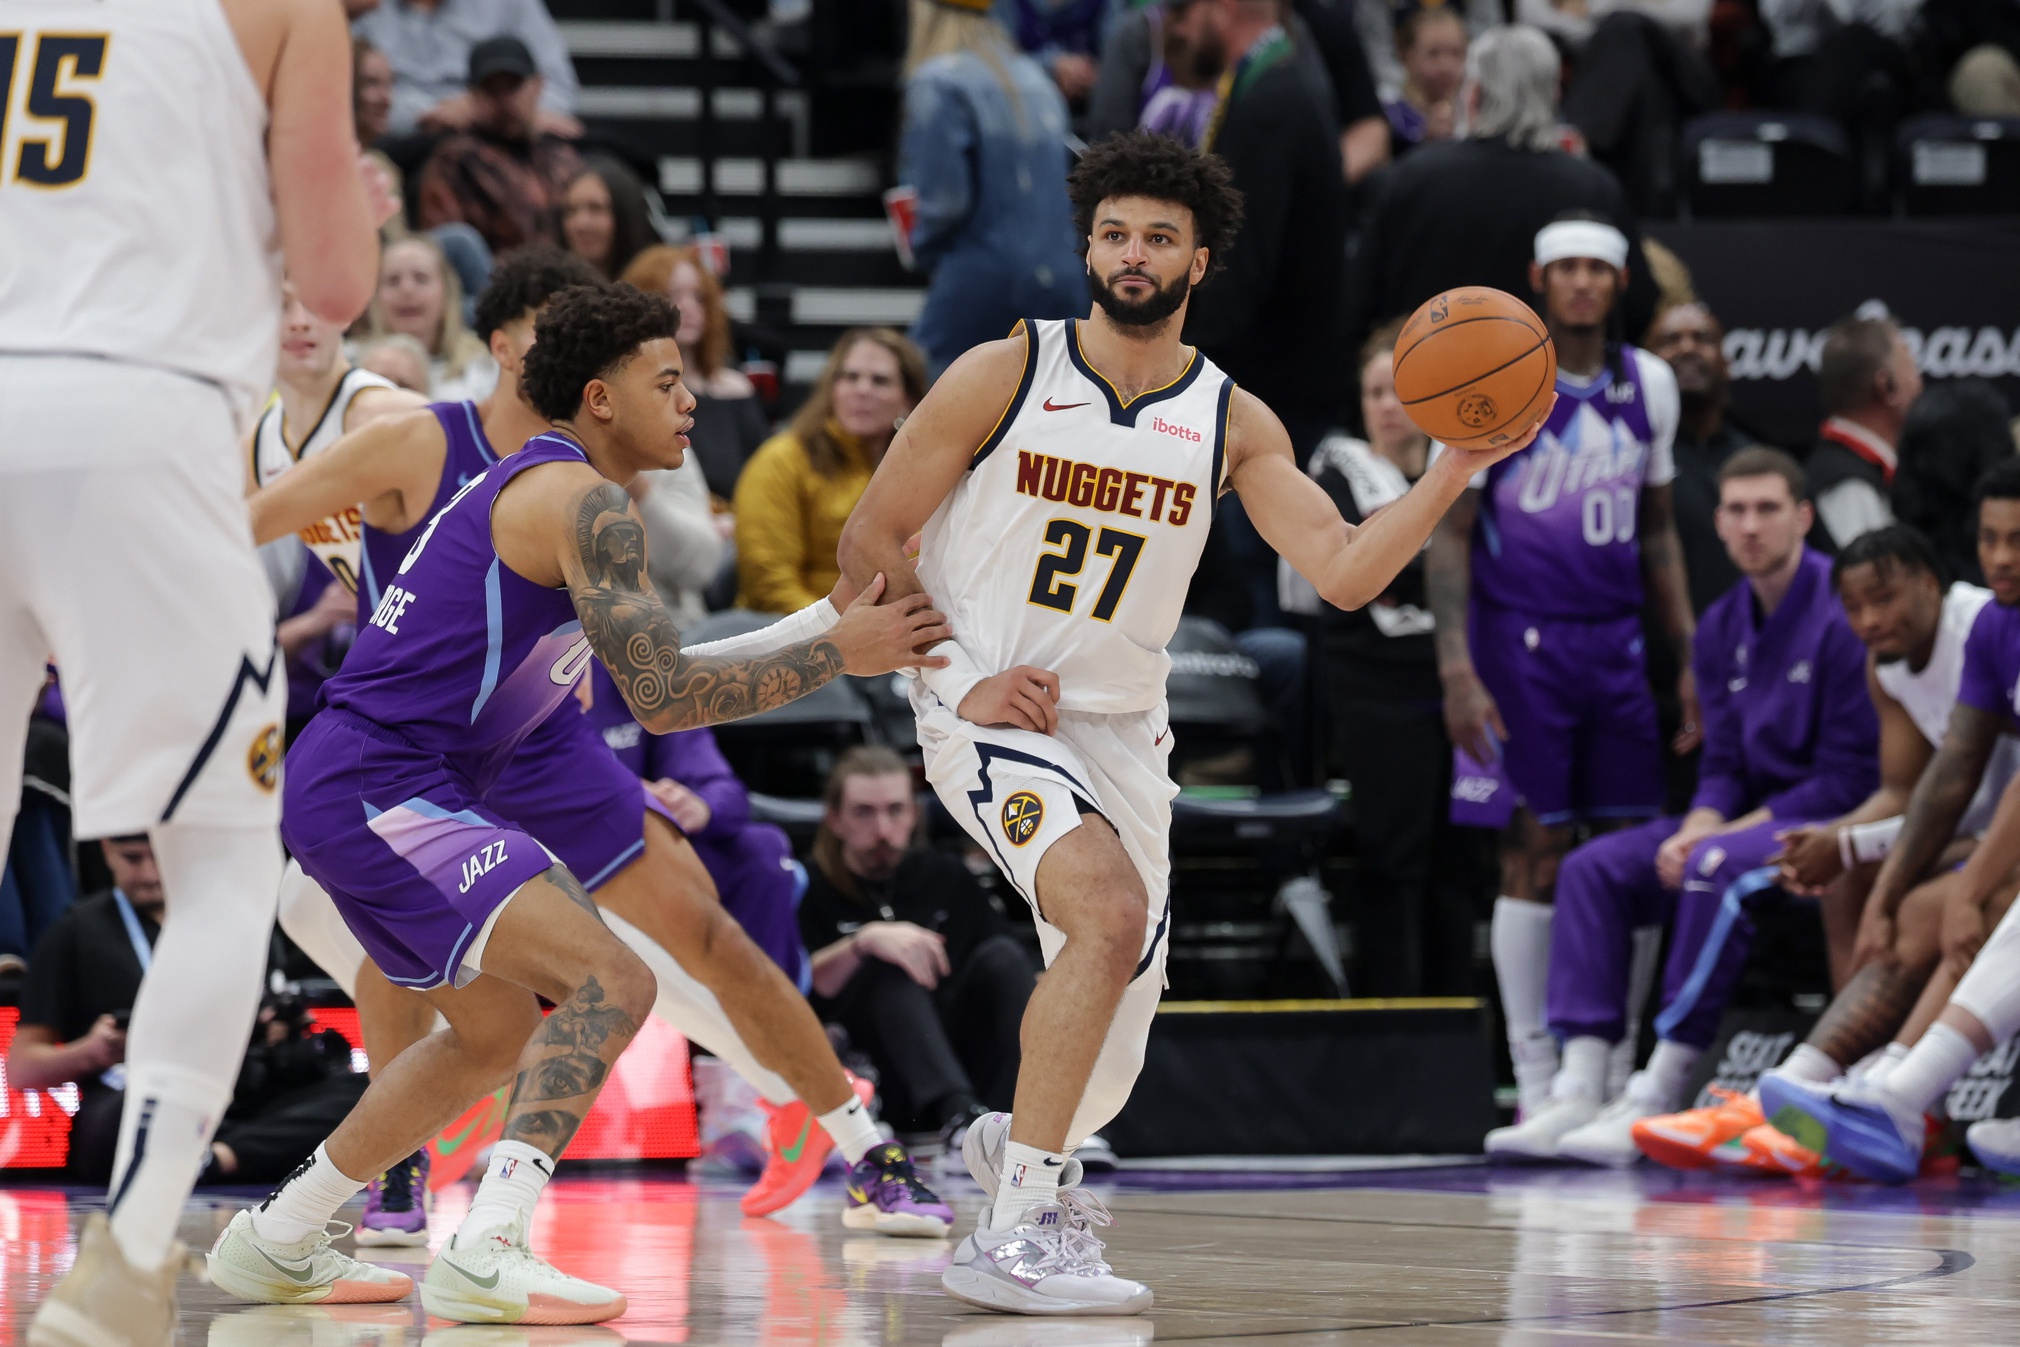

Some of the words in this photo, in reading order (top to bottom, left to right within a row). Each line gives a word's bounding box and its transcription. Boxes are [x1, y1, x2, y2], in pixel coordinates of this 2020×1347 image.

[1152, 416, 1201, 442] ibotta
[1015, 449, 1198, 529] NUGGETS
[1026, 517, 1149, 624] 27
[458, 839, 509, 894] JAZZ
